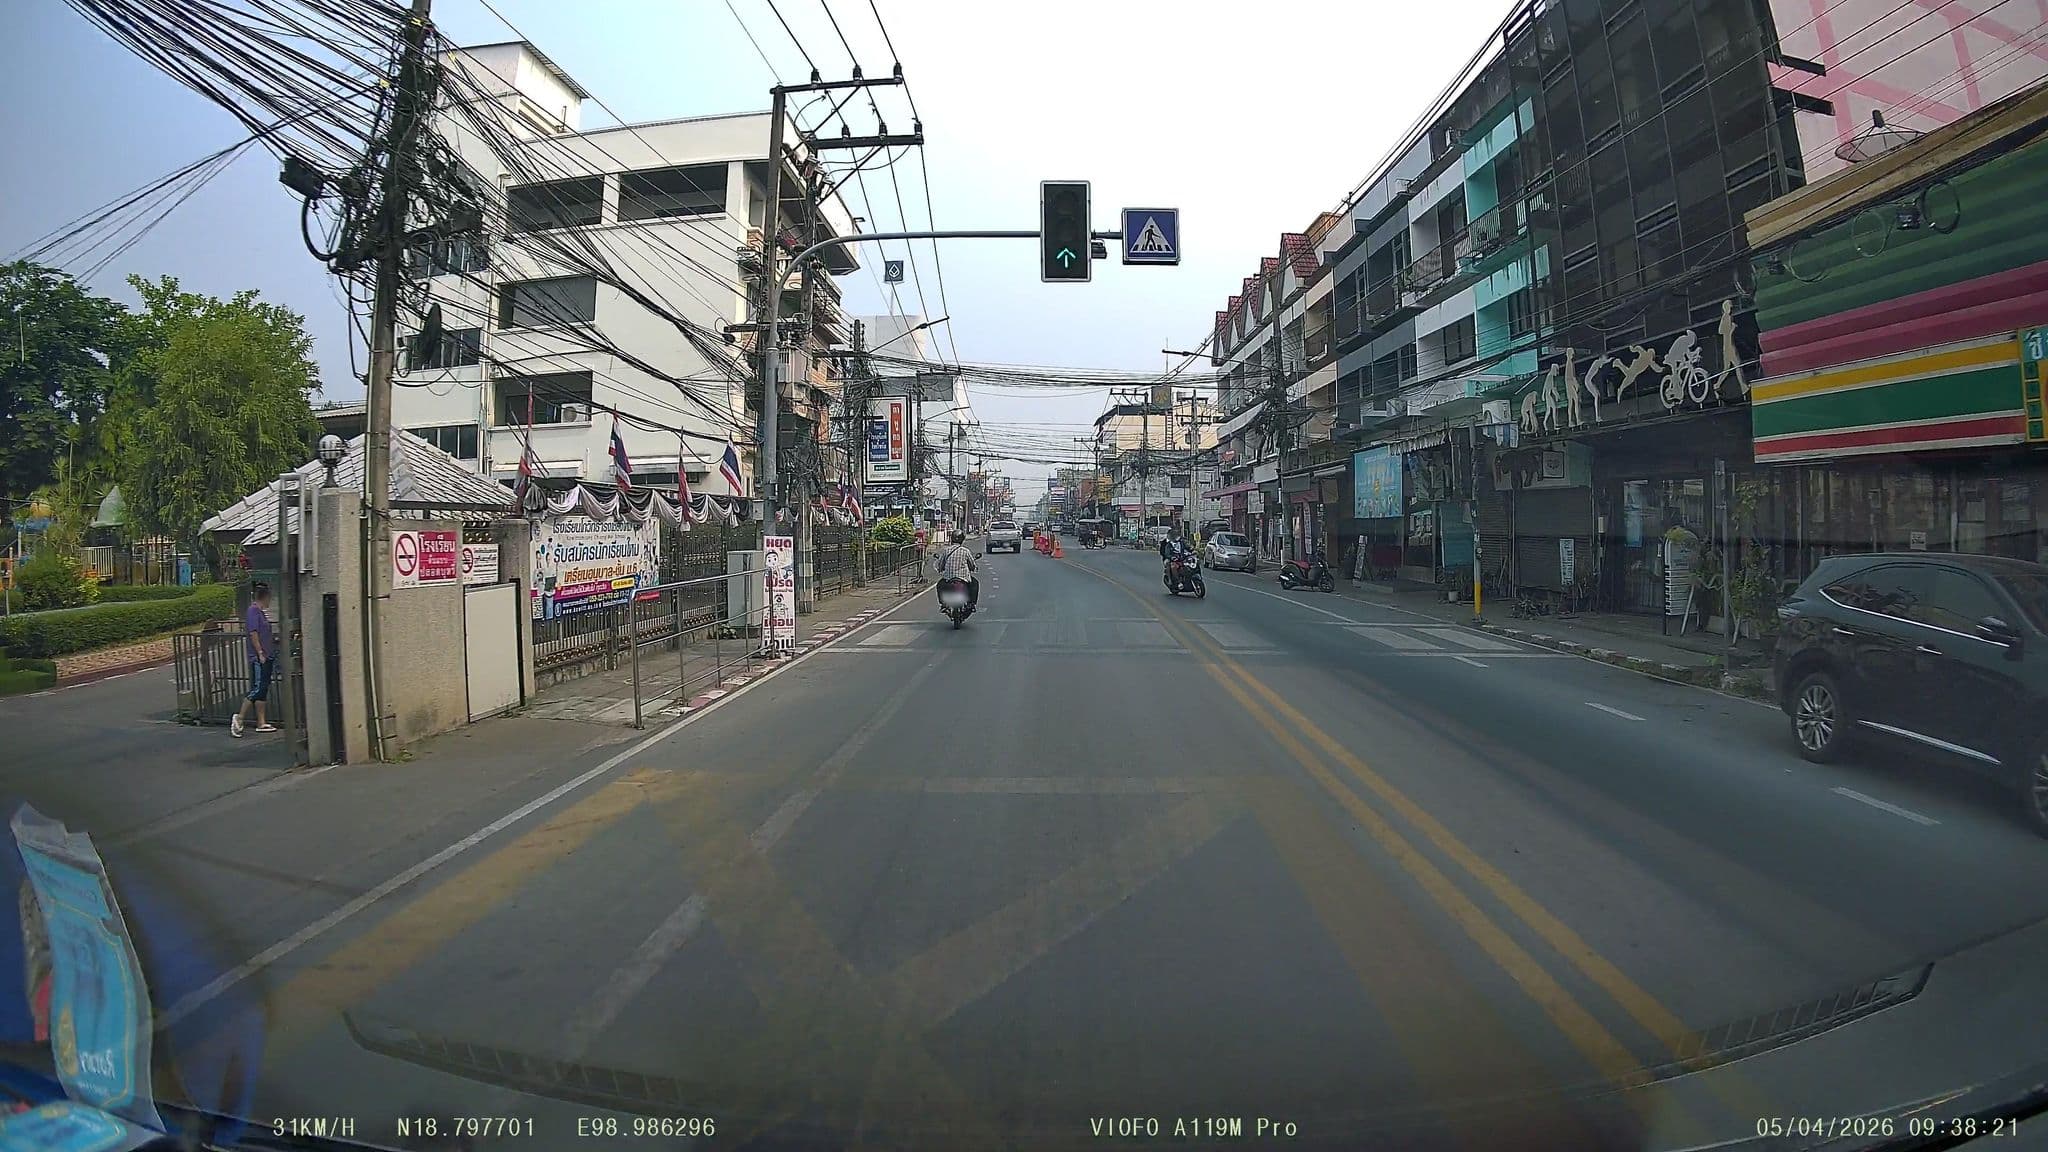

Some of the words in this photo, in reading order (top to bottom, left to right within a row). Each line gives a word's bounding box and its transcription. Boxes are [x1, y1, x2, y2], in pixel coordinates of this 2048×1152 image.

[419, 534, 455, 552] โรงเรียน
[553, 538, 639, 563] รับสมัครนักเรียนใหม่
[766, 538, 792, 551] หยุด
